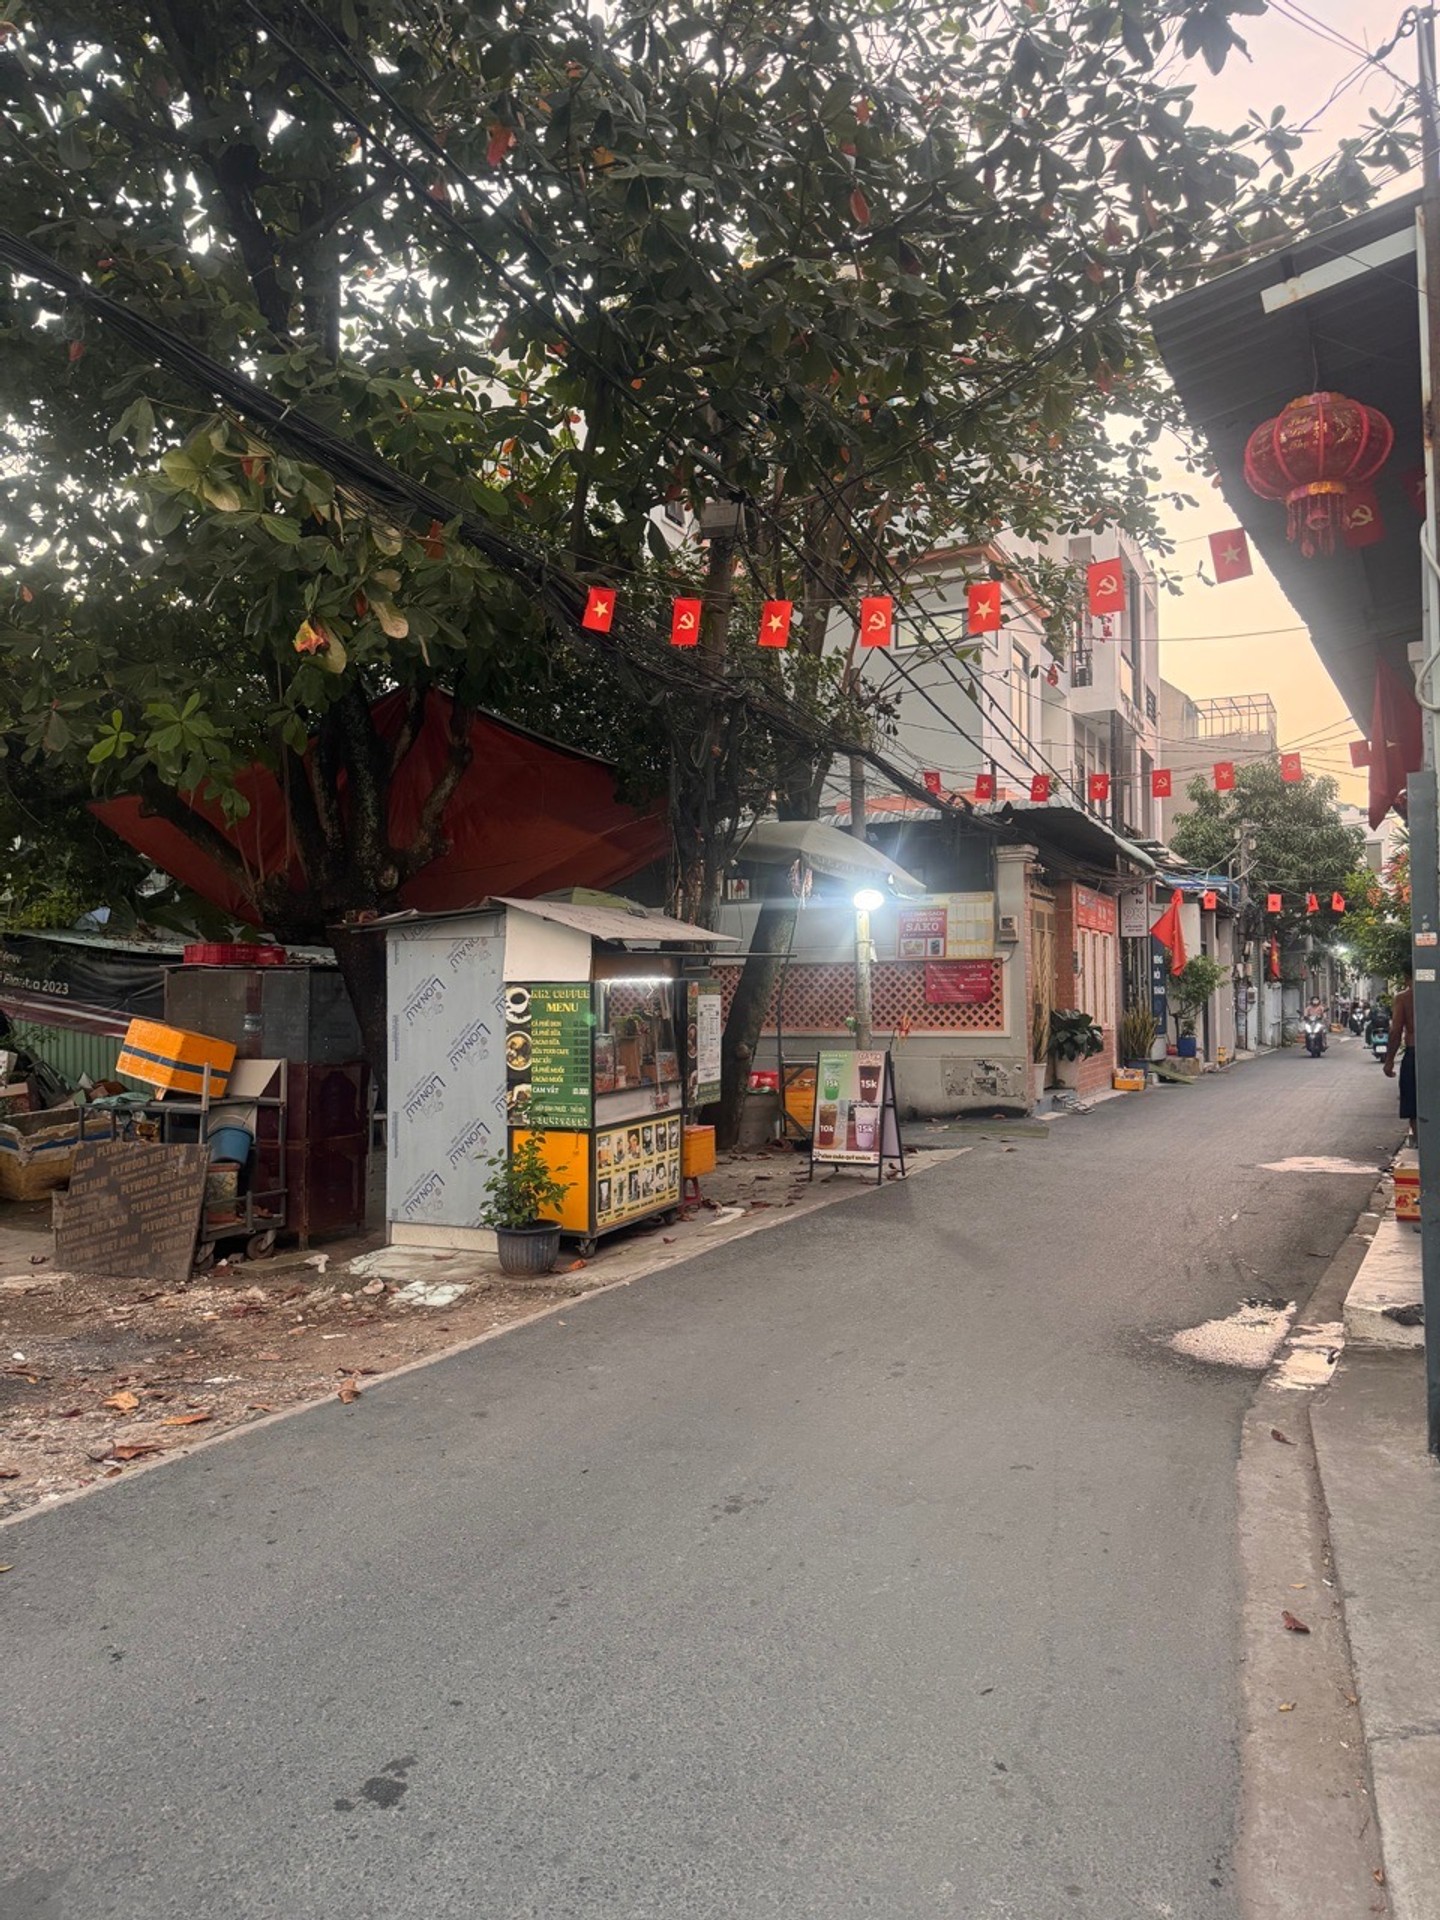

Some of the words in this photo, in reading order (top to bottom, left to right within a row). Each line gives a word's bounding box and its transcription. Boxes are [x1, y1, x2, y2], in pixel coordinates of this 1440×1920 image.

[905, 922, 939, 931] SAKO
[42, 979, 69, 995] 2023
[406, 978, 447, 1021] LIONALU
[546, 1002, 579, 1013] MENU
[449, 1023, 491, 1066] LIONALU
[406, 1075, 446, 1119] LIONALU
[860, 1079, 877, 1089] 15k
[820, 1124, 834, 1133] 10k
[449, 1122, 491, 1166] LIONALU
[405, 1173, 446, 1216] LIONALU
